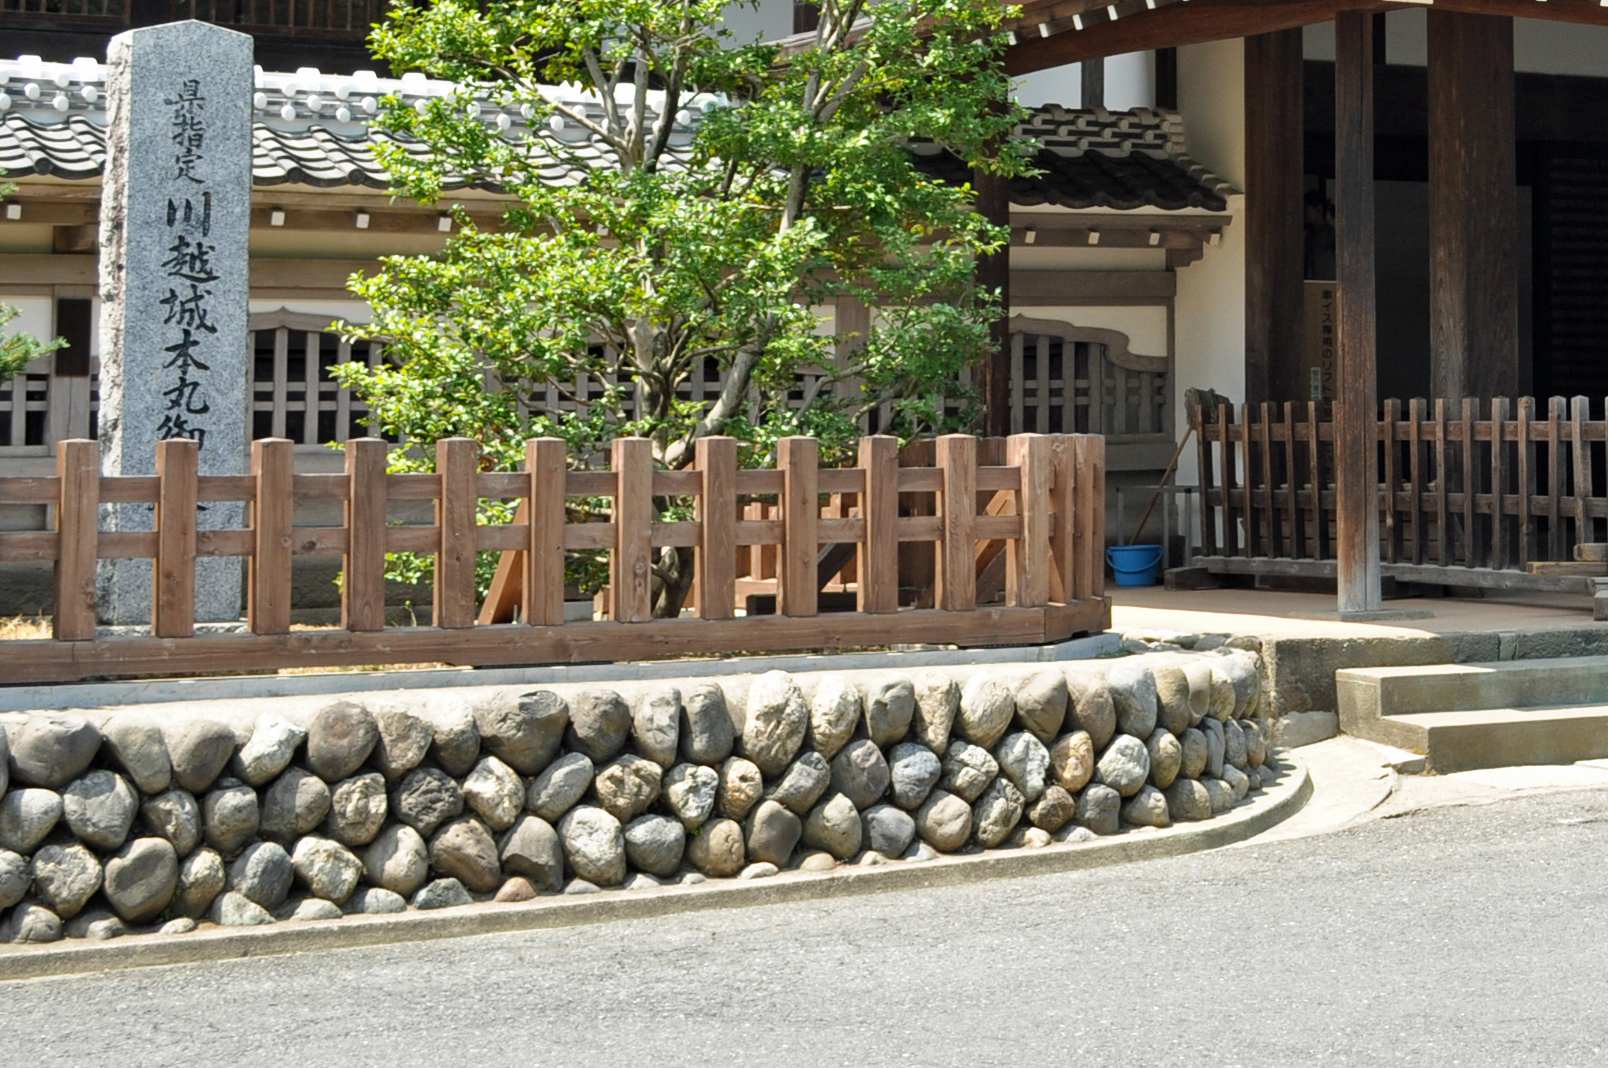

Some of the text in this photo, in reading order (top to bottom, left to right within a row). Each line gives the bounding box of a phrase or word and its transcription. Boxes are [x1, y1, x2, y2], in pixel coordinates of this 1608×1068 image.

[147, 78, 220, 511] 県指定川越城本丸御
